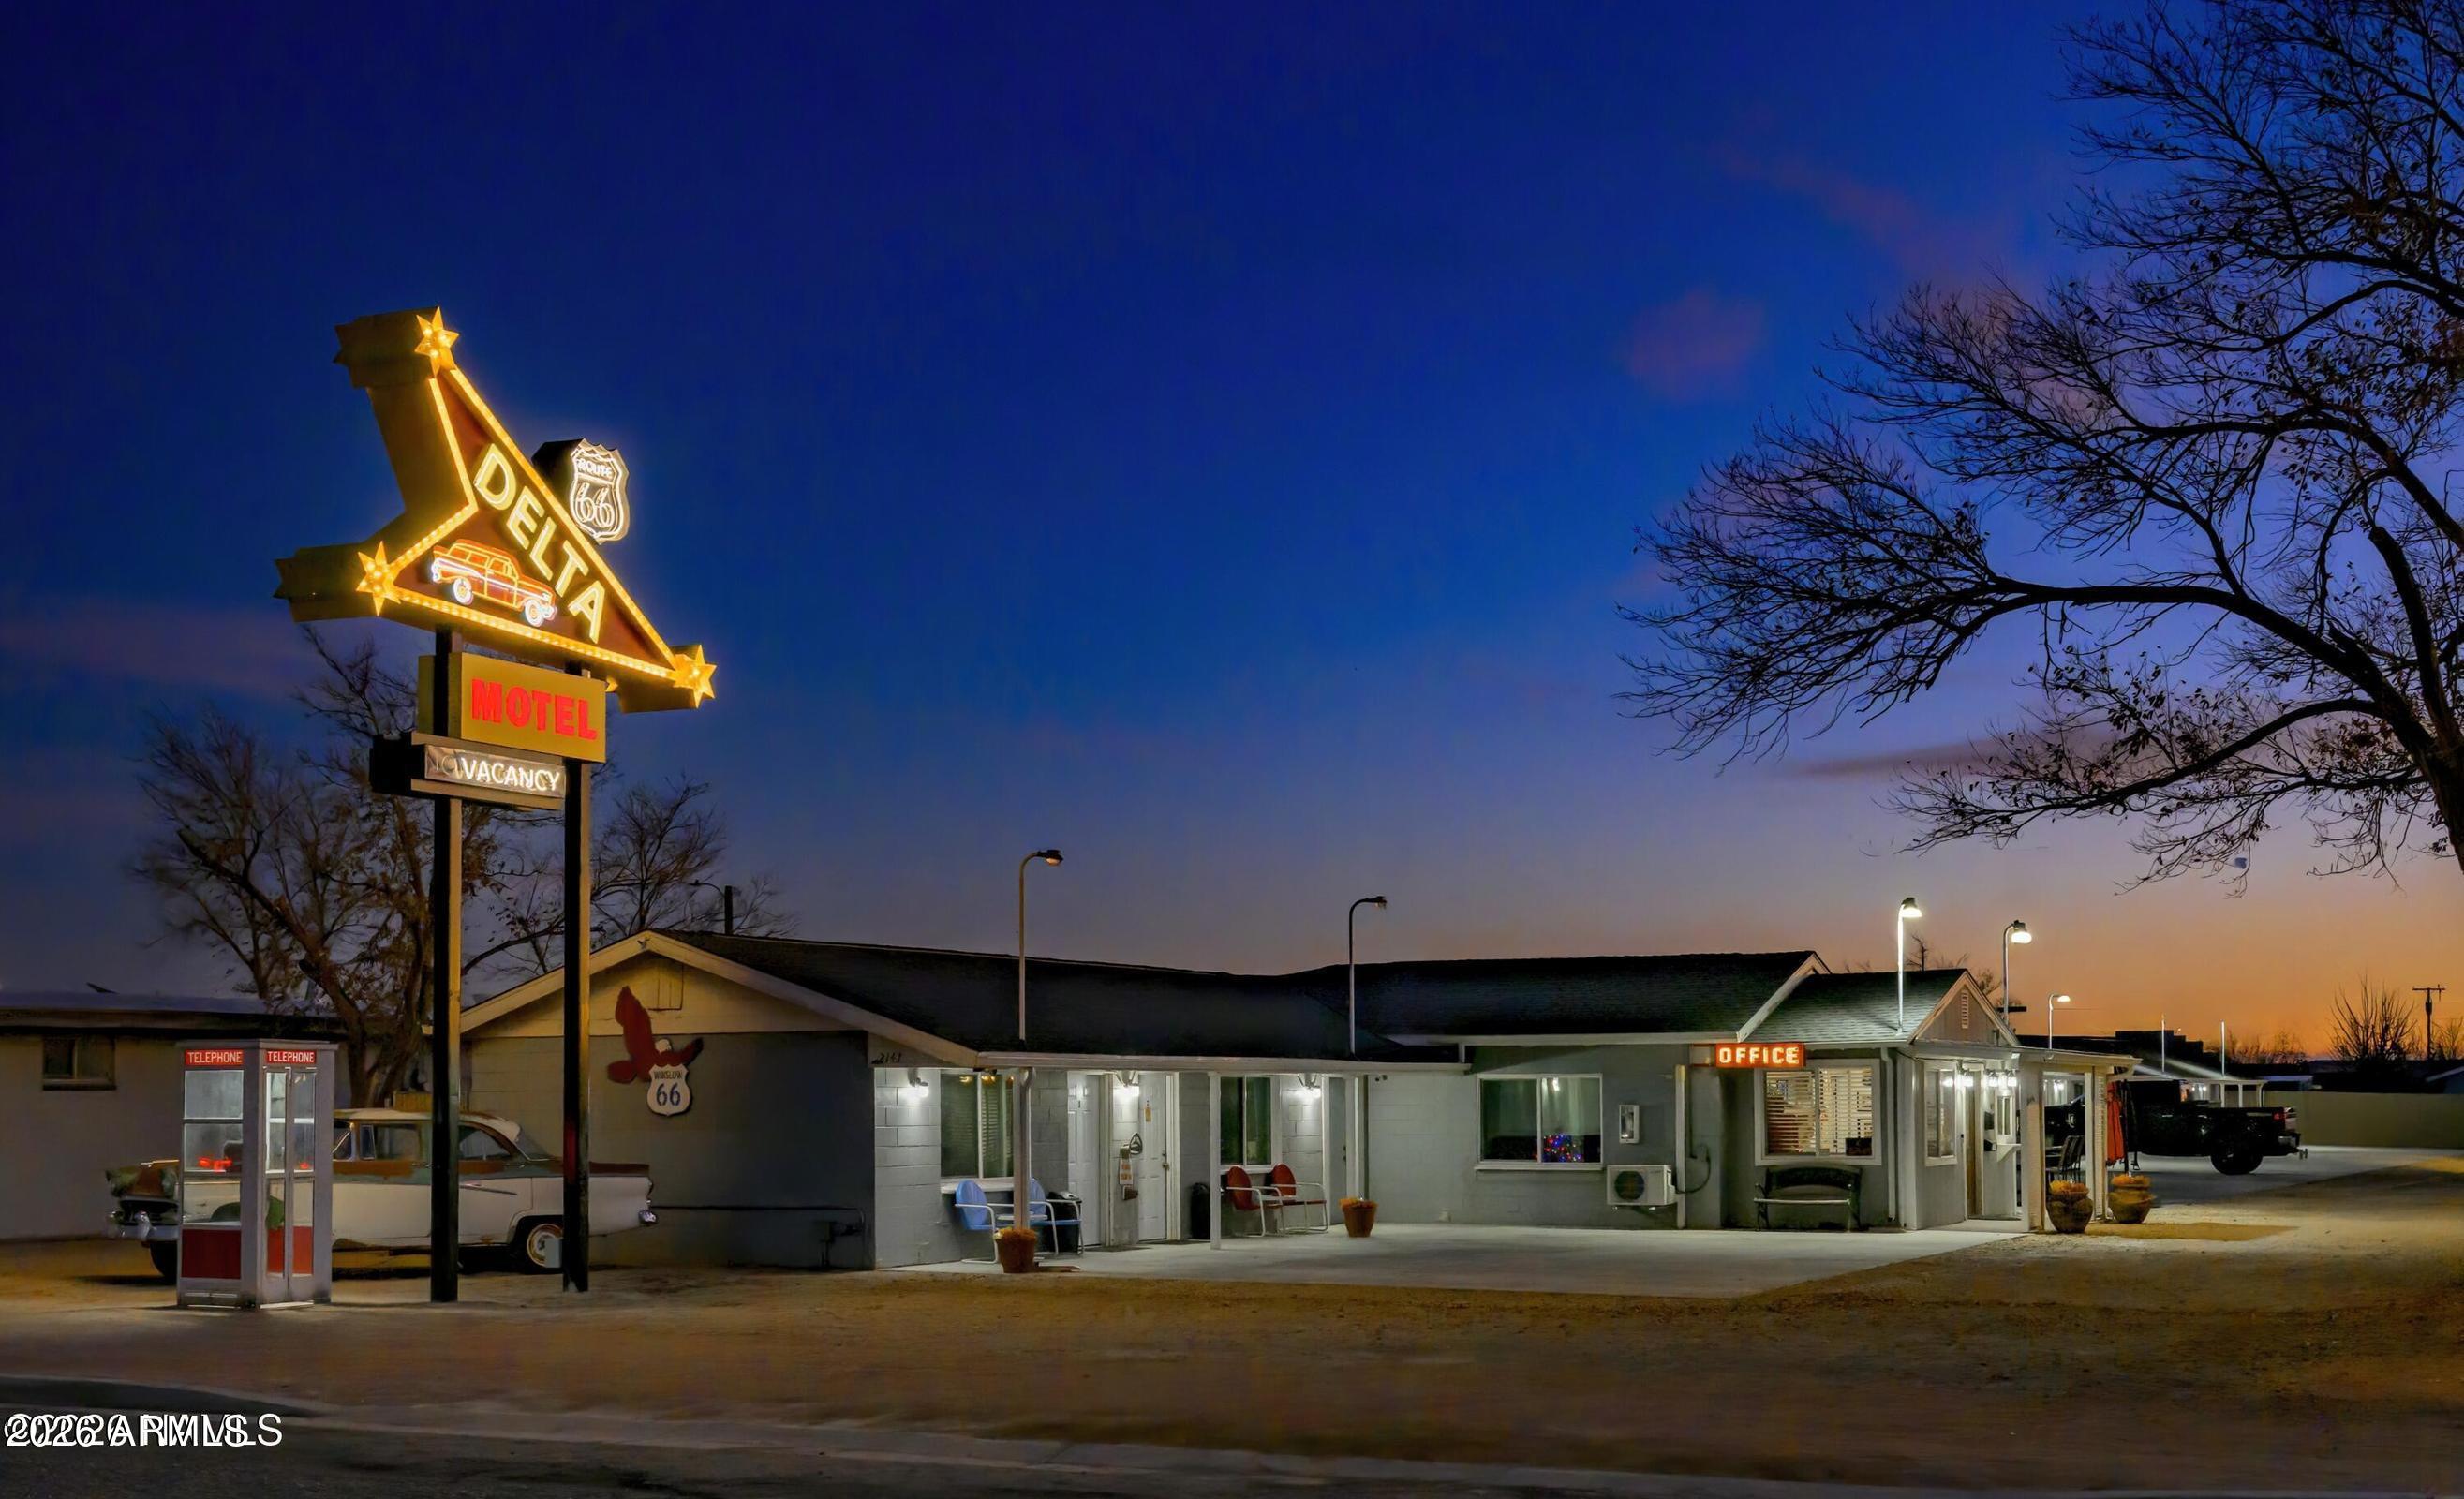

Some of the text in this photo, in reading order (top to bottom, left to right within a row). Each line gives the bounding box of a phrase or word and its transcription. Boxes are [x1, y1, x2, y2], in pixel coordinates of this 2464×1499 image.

[576, 458, 614, 479] ROUTE
[574, 482, 616, 527] 66
[474, 443, 605, 644] DELTA
[471, 678, 598, 740] MOTEL
[460, 756, 560, 792] VACANCY
[187, 1051, 243, 1063] TELEPHONE
[267, 1050, 315, 1063] TELEPHONE
[1719, 1047, 1799, 1064] OFFICE
[656, 1082, 681, 1106] 66
